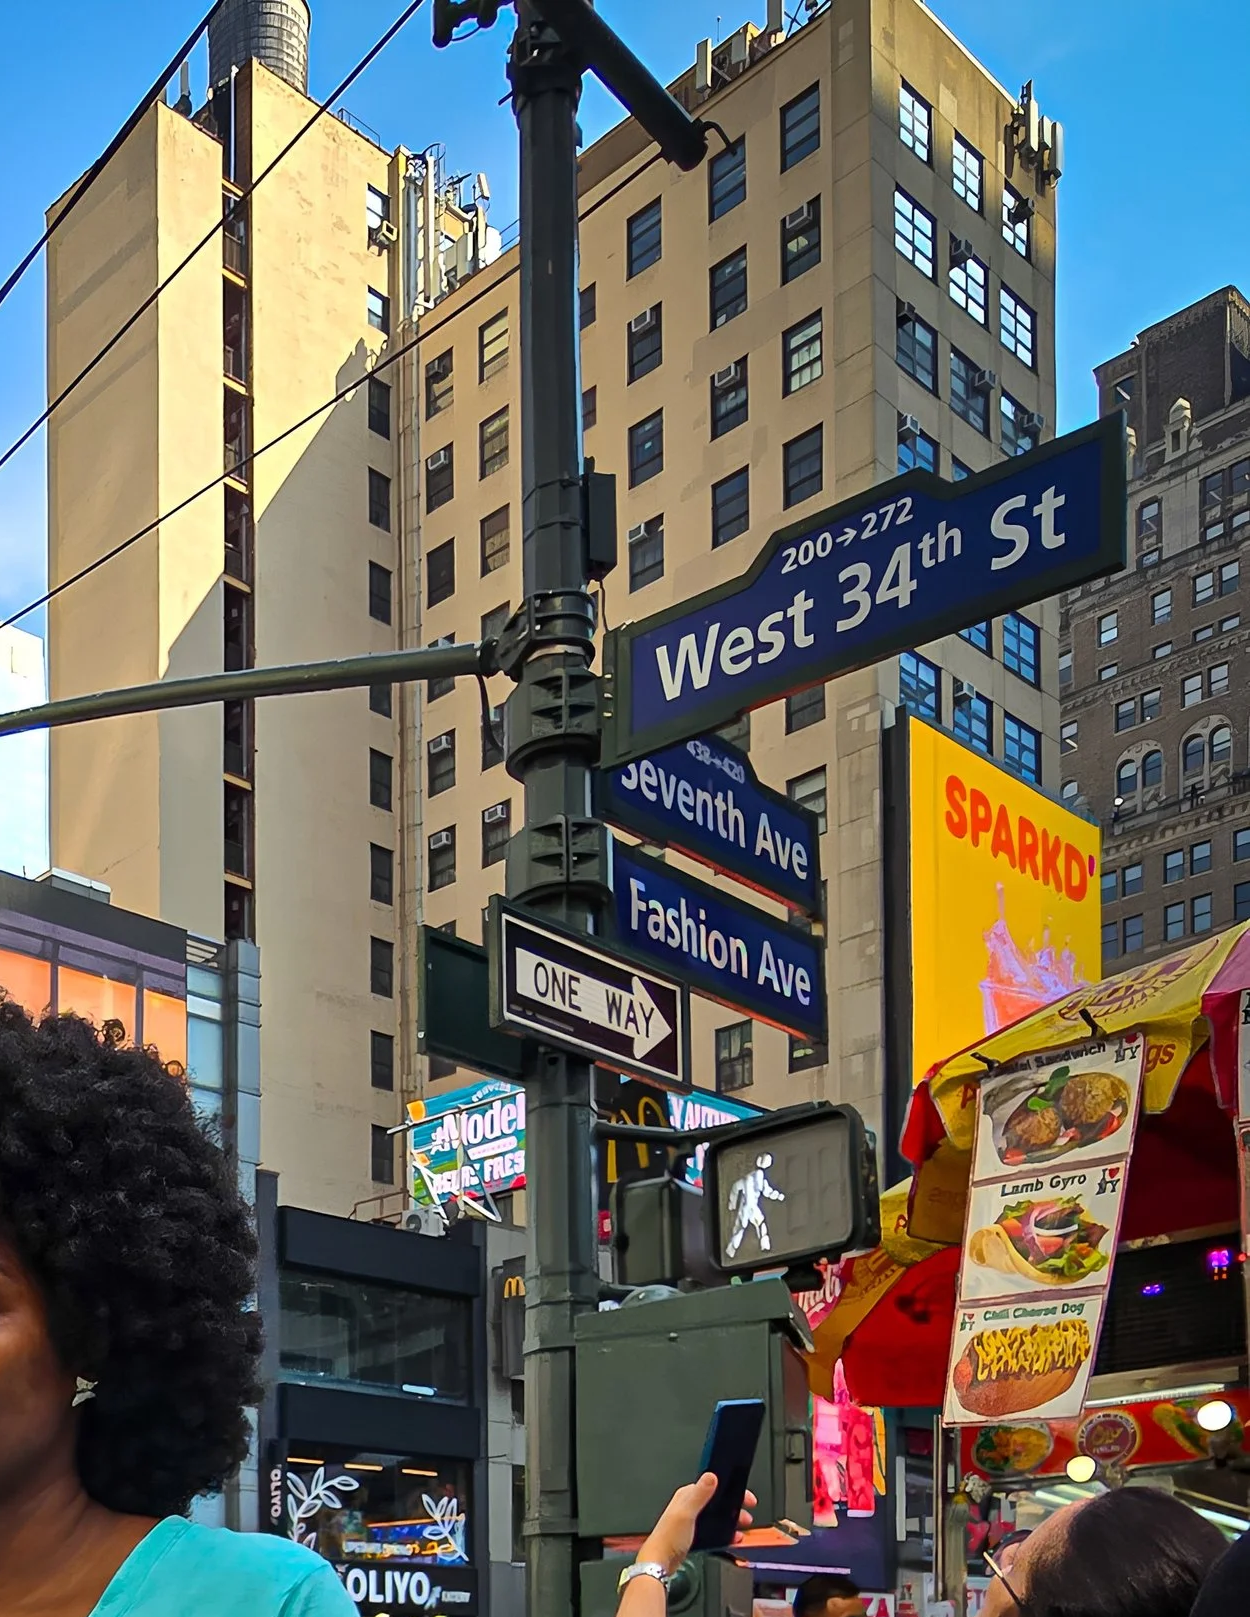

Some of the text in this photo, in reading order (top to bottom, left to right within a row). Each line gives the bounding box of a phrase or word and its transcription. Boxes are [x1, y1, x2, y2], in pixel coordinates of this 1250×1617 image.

[781, 496, 915, 575] 200 272
[655, 485, 1067, 701] West 34th St
[754, 813, 808, 880] Ave
[629, 877, 811, 1006] Fashion Ave
[533, 961, 582, 1012] ONE
[605, 988, 656, 1039] WAY
[430, 1092, 526, 1155] Model
[1000, 1173, 1088, 1198] Lamb Gyro
[1061, 1302, 1085, 1316] Dog
[346, 1569, 431, 1605] OLIYO
